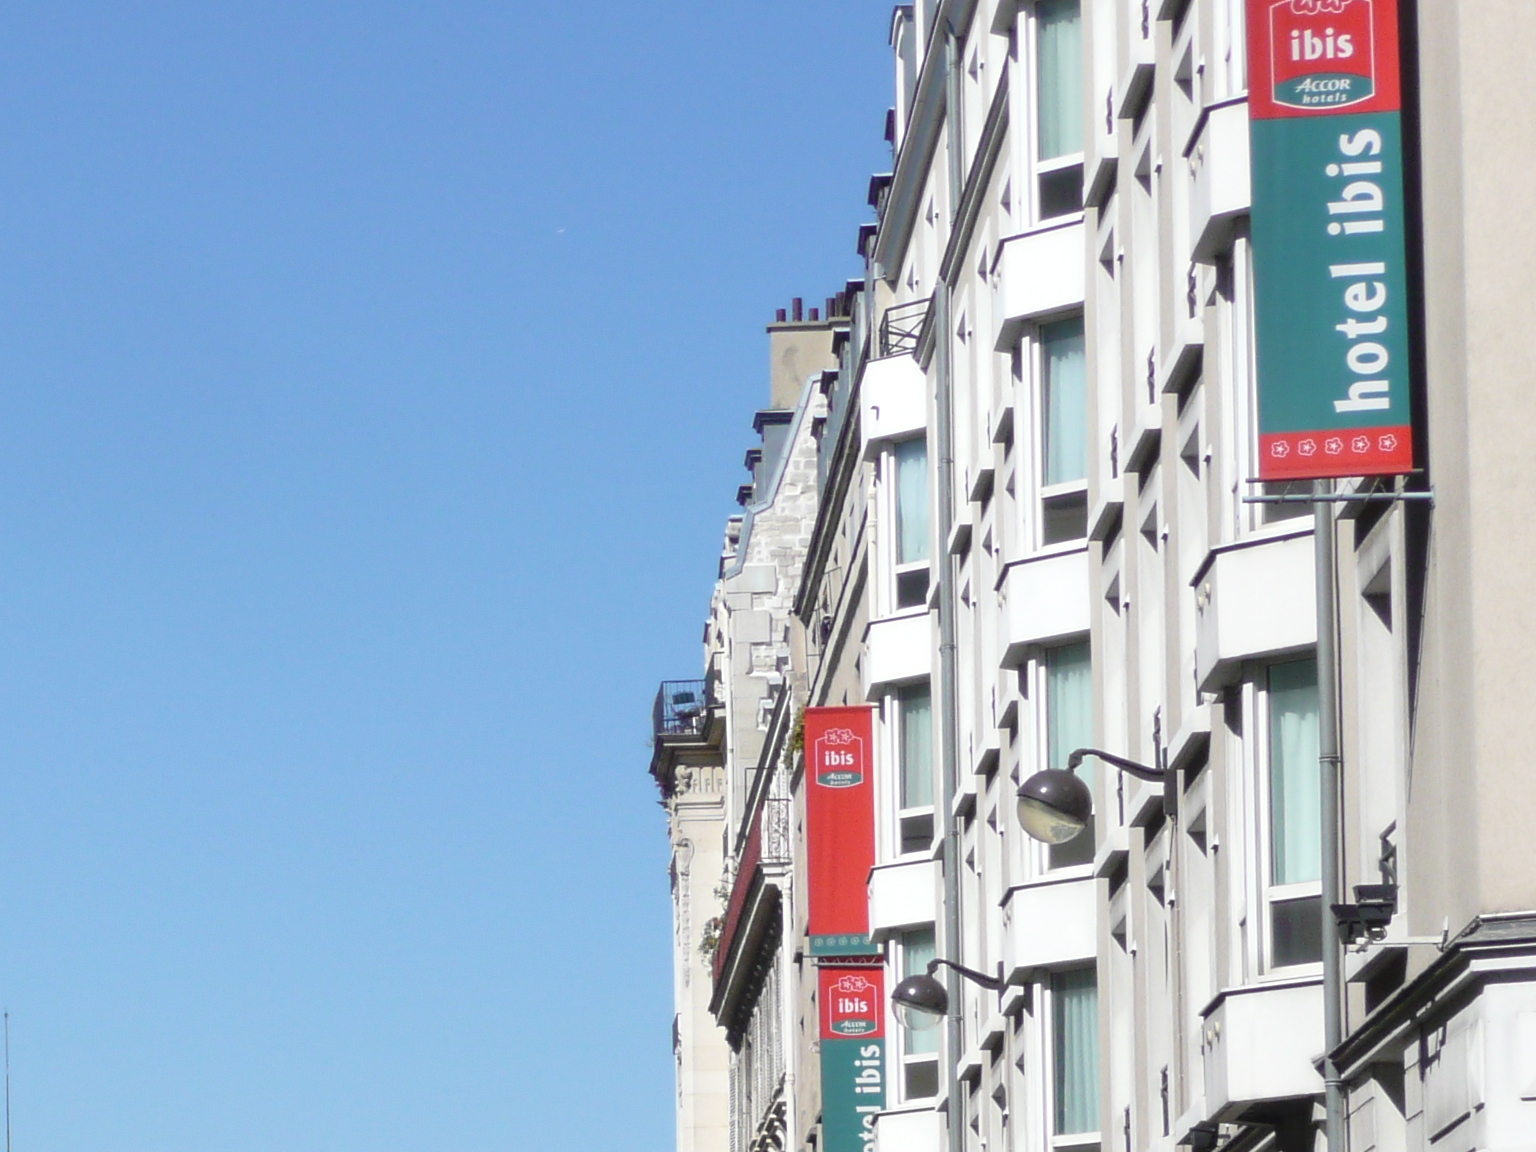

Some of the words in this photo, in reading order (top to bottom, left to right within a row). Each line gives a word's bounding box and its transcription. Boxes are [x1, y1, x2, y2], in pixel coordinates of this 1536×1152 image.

[1291, 27, 1353, 61] ibis
[1295, 77, 1352, 94] ACCOR
[1302, 93, 1347, 104] hotels
[1326, 128, 1386, 237] ibis
[1329, 262, 1391, 413] hotel
[824, 750, 854, 766] ibis
[838, 998, 868, 1013] ibis
[854, 1044, 881, 1094] ibis
